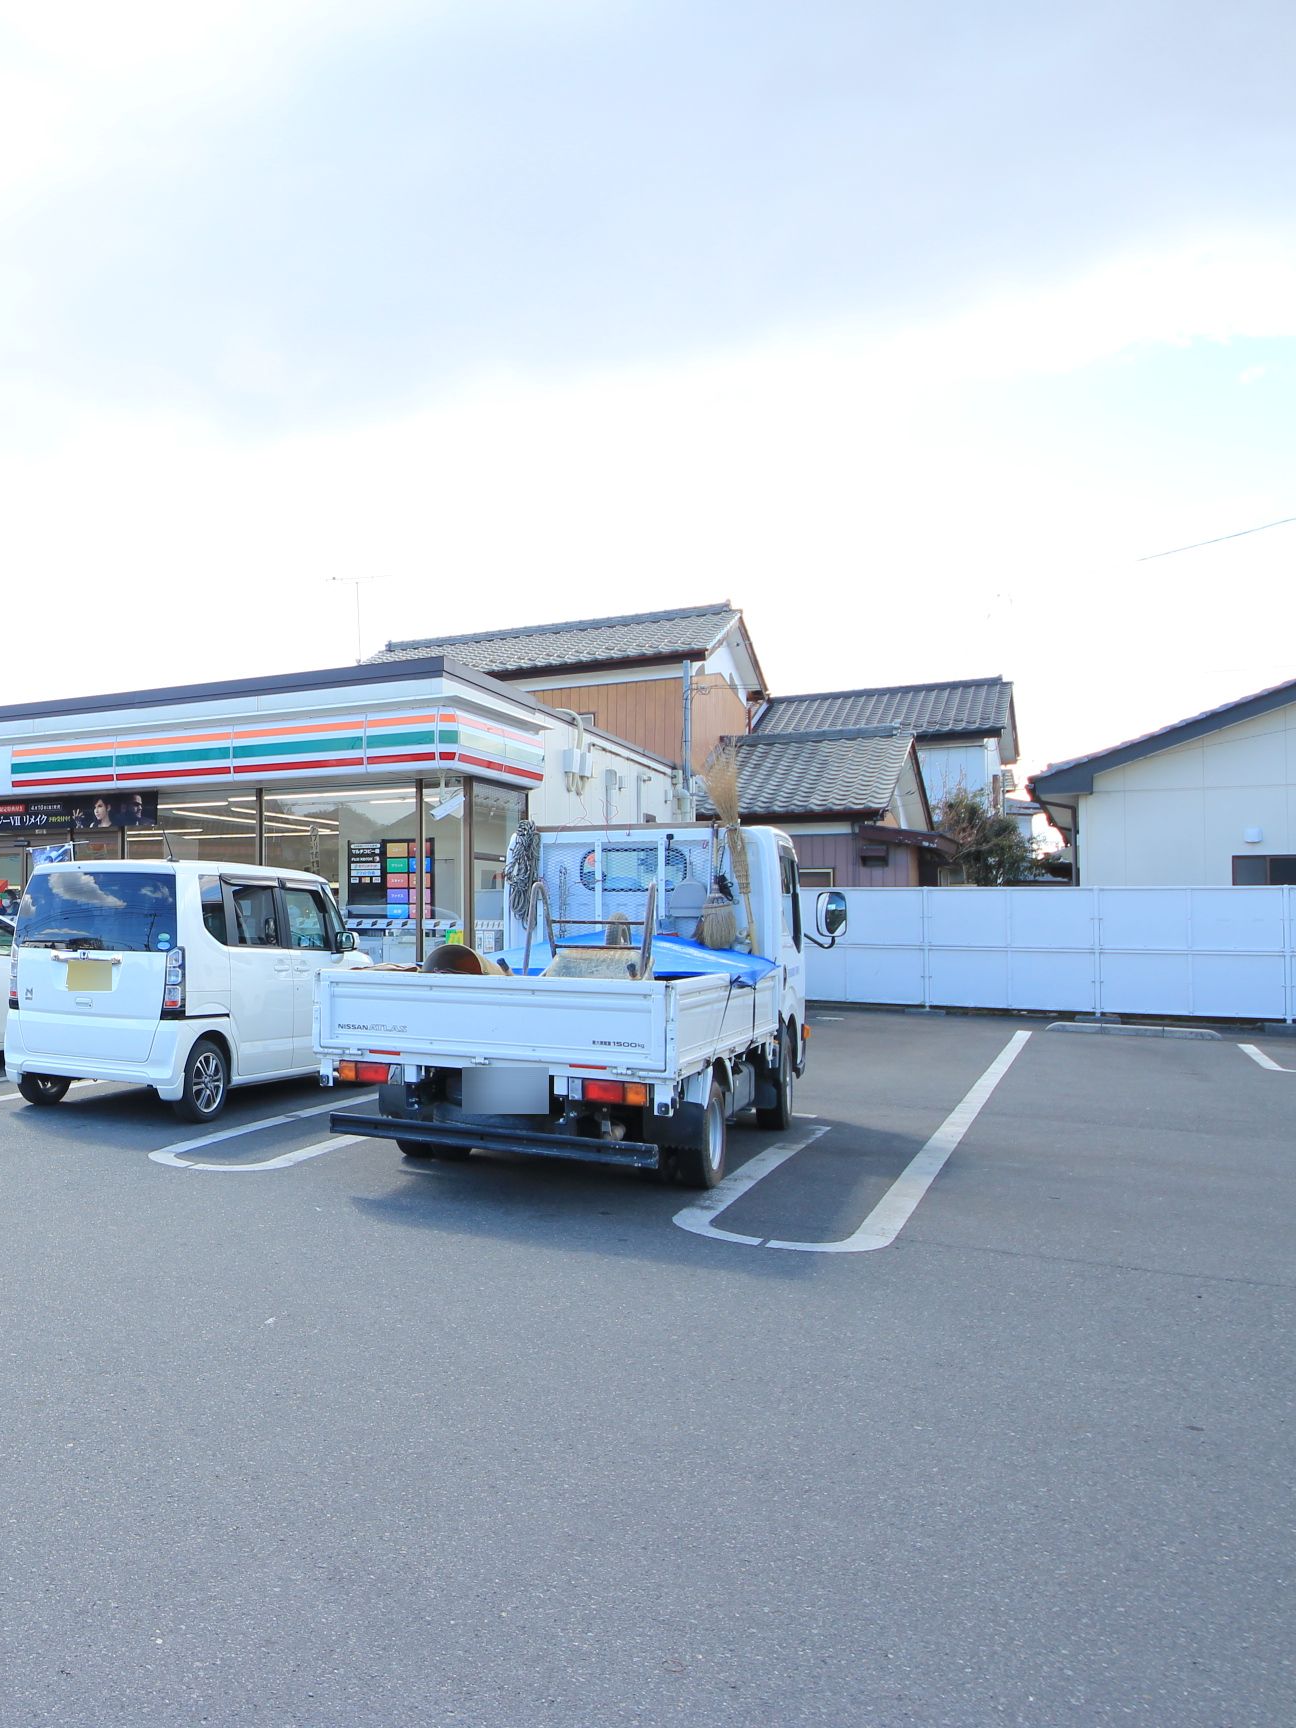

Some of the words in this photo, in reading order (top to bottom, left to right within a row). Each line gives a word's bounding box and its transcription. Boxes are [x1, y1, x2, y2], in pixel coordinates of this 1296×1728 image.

[23, 814, 48, 826] リメイク
[337, 1023, 368, 1031] NISSAN
